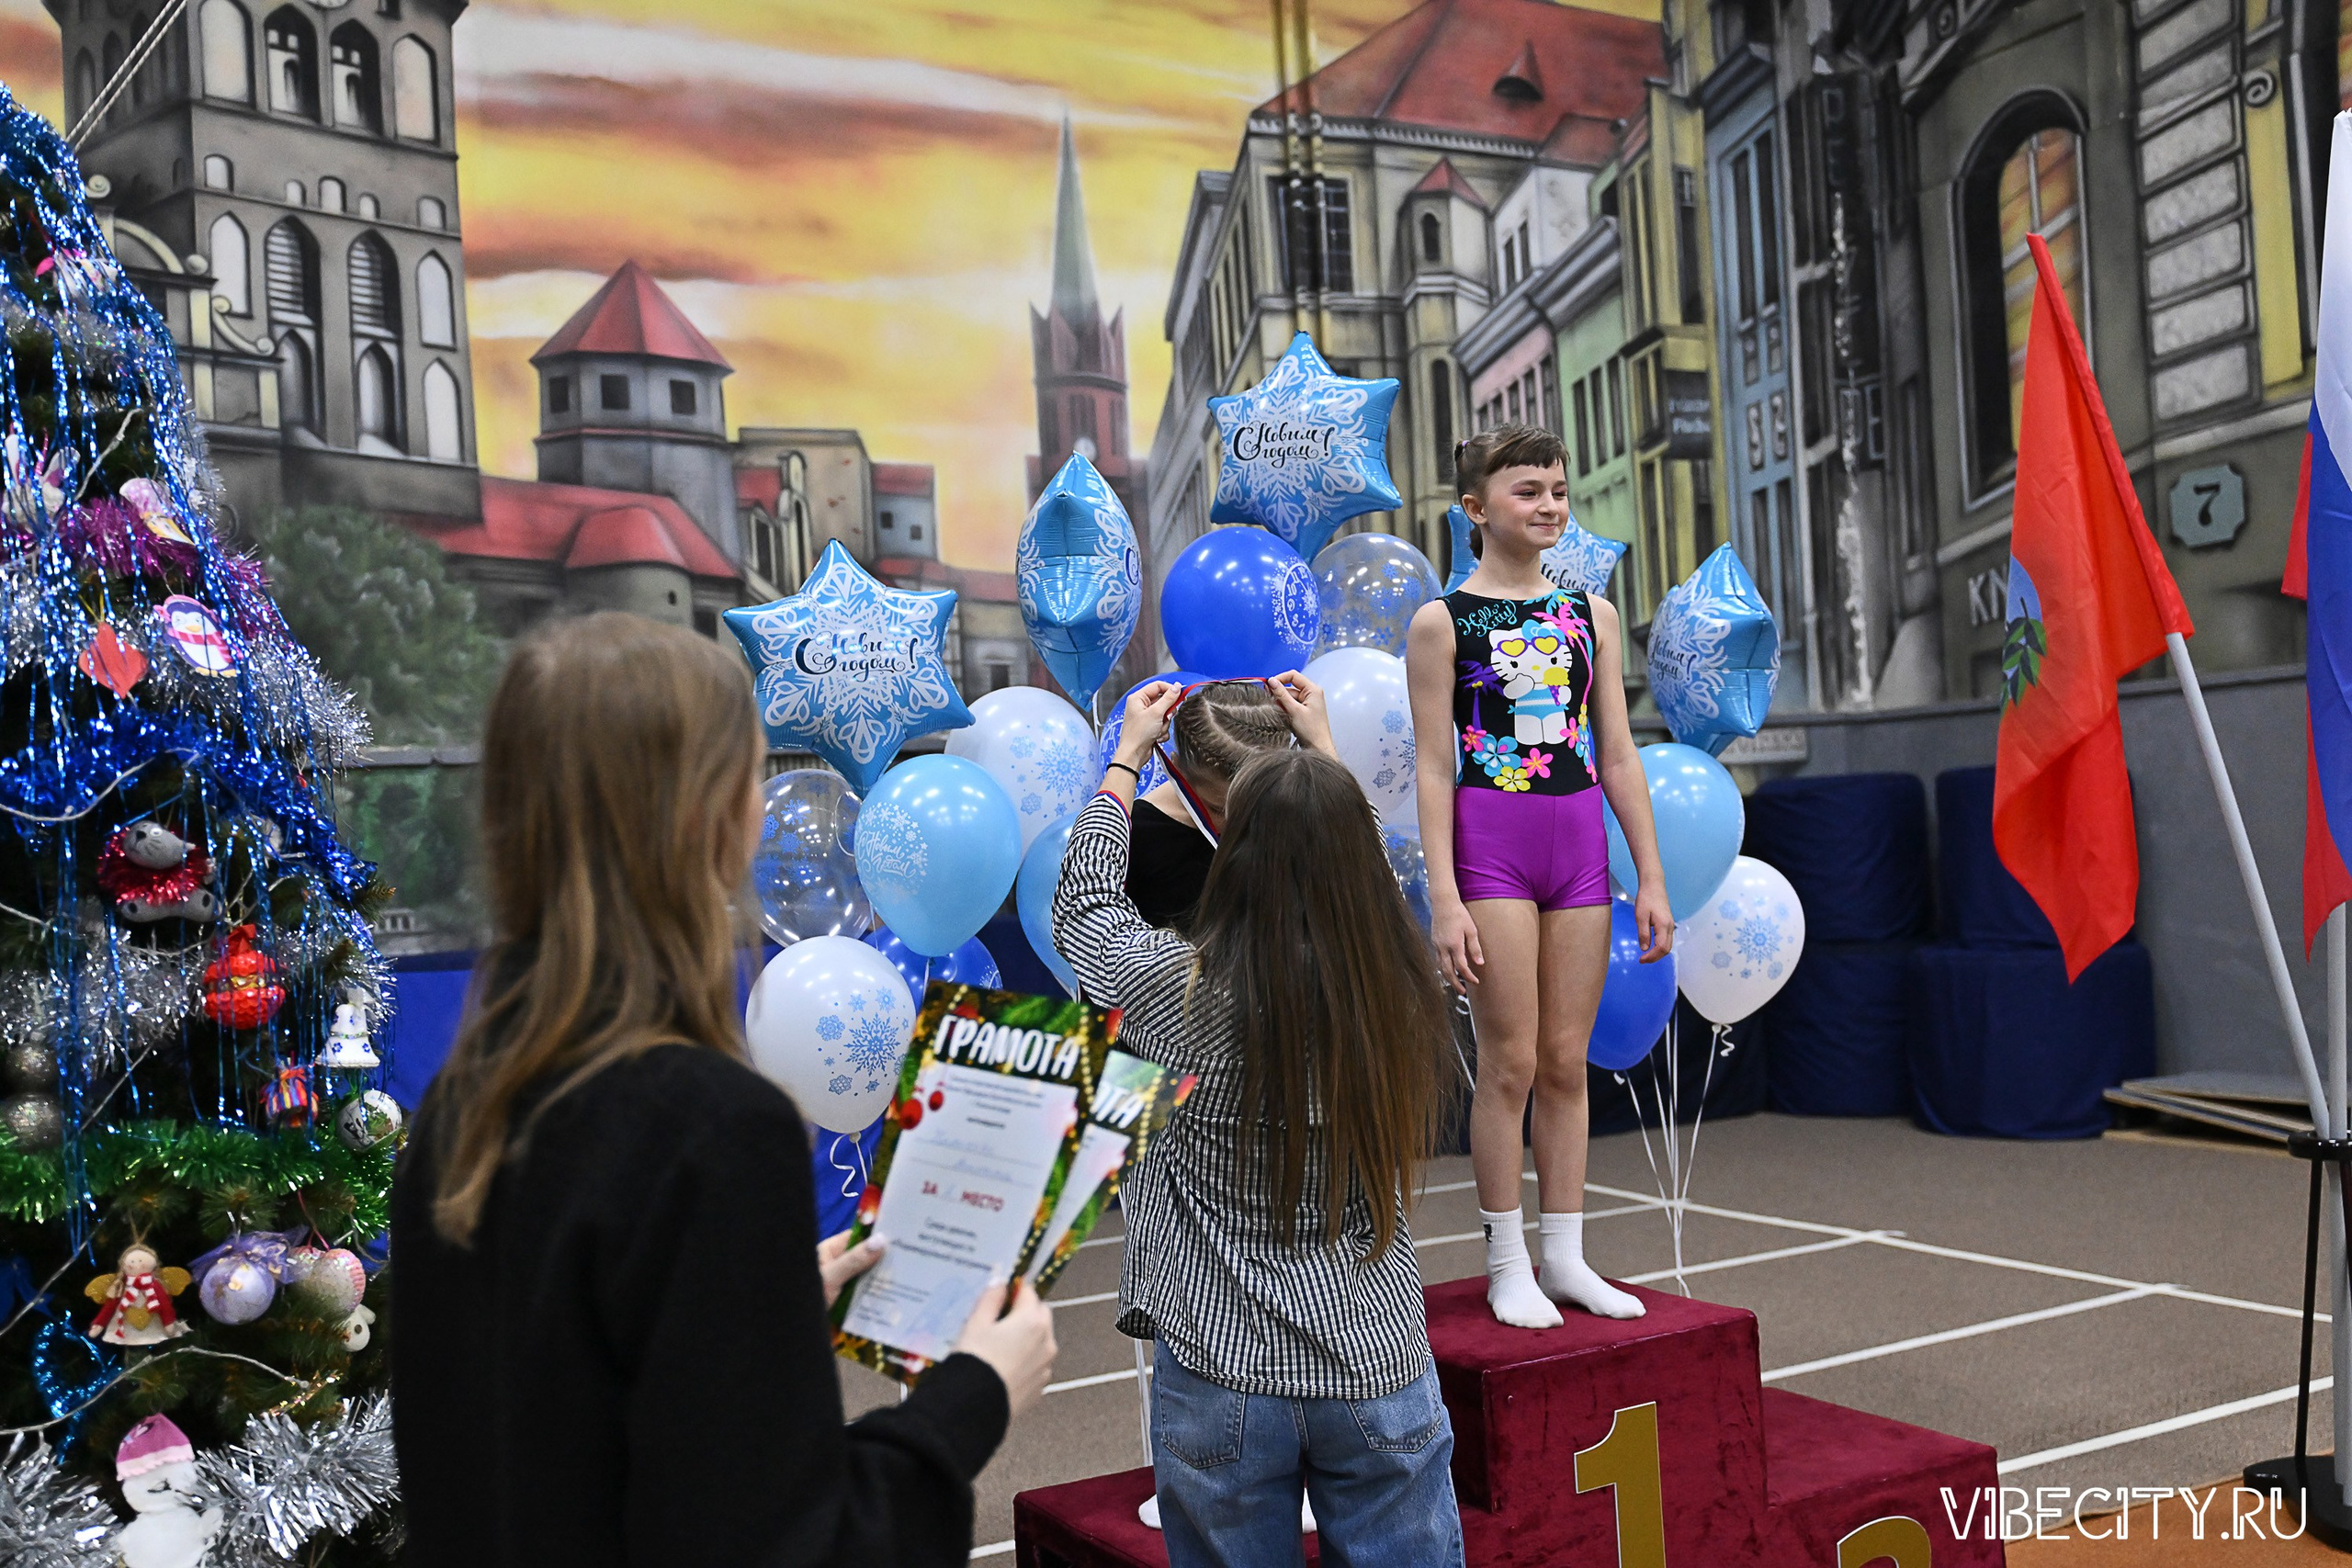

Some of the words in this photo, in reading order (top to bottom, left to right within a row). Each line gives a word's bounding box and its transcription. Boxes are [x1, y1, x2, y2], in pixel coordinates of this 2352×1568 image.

[2193, 480, 2222, 528] 7
[1457, 604, 1499, 636] Hello
[1476, 599, 1518, 637] Kitty
[933, 1013, 1081, 1081] ГРАМОТА
[1574, 1401, 1667, 1568] 1
